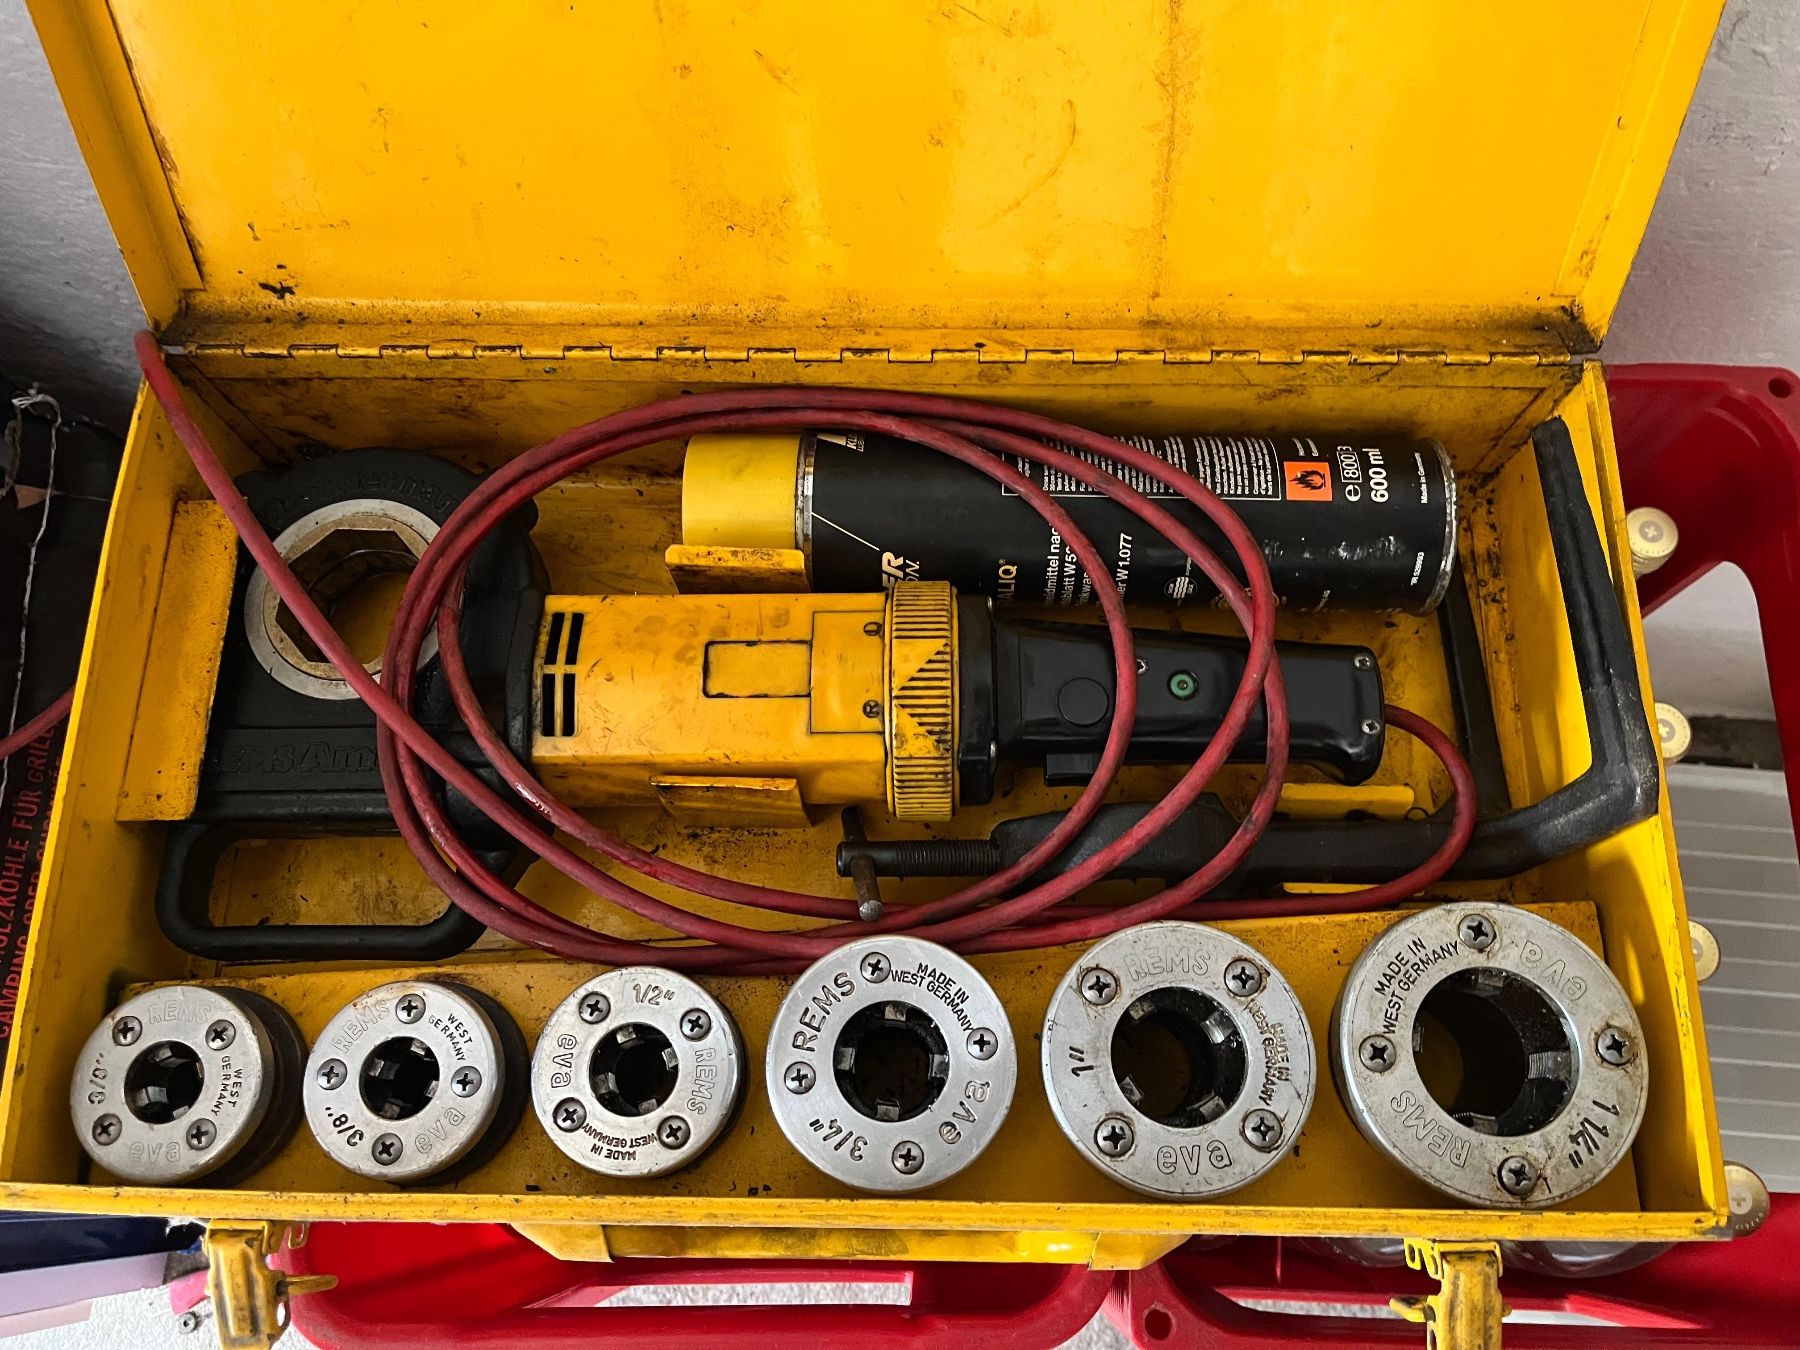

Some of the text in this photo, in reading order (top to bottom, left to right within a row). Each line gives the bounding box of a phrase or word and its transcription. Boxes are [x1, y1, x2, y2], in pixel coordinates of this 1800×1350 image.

[1341, 454, 1359, 478] 800
[1362, 448, 1389, 503] 600 ml
[11, 790, 43, 831] FÜR
[916, 962, 970, 1004] MADE IN
[1124, 949, 1211, 982] REMS
[1375, 937, 1427, 996] MADE IN
[1382, 941, 1461, 1035] WEST GERMANY
[1520, 940, 1588, 1001] eva
[147, 1000, 212, 1025] REMS
[632, 983, 675, 1006] 1/2"
[792, 971, 856, 1053] REMS
[890, 969, 975, 1033] WEST GERMANY
[331, 999, 390, 1054] REMS
[428, 1015, 466, 1062] GERMANY
[447, 1013, 473, 1045] WEST
[551, 1033, 577, 1089] eva
[686, 1047, 717, 1116] REMS
[211, 1055, 231, 1117] GERMANY
[228, 1069, 243, 1108] WEST
[414, 1107, 466, 1154] eva
[582, 1123, 658, 1149] WEST GERMANY
[938, 1080, 990, 1145] eva
[1391, 1091, 1472, 1169] REMS
[128, 1141, 181, 1163] eva
[590, 1143, 637, 1161] MADE IN
[1156, 1140, 1233, 1175] eva
